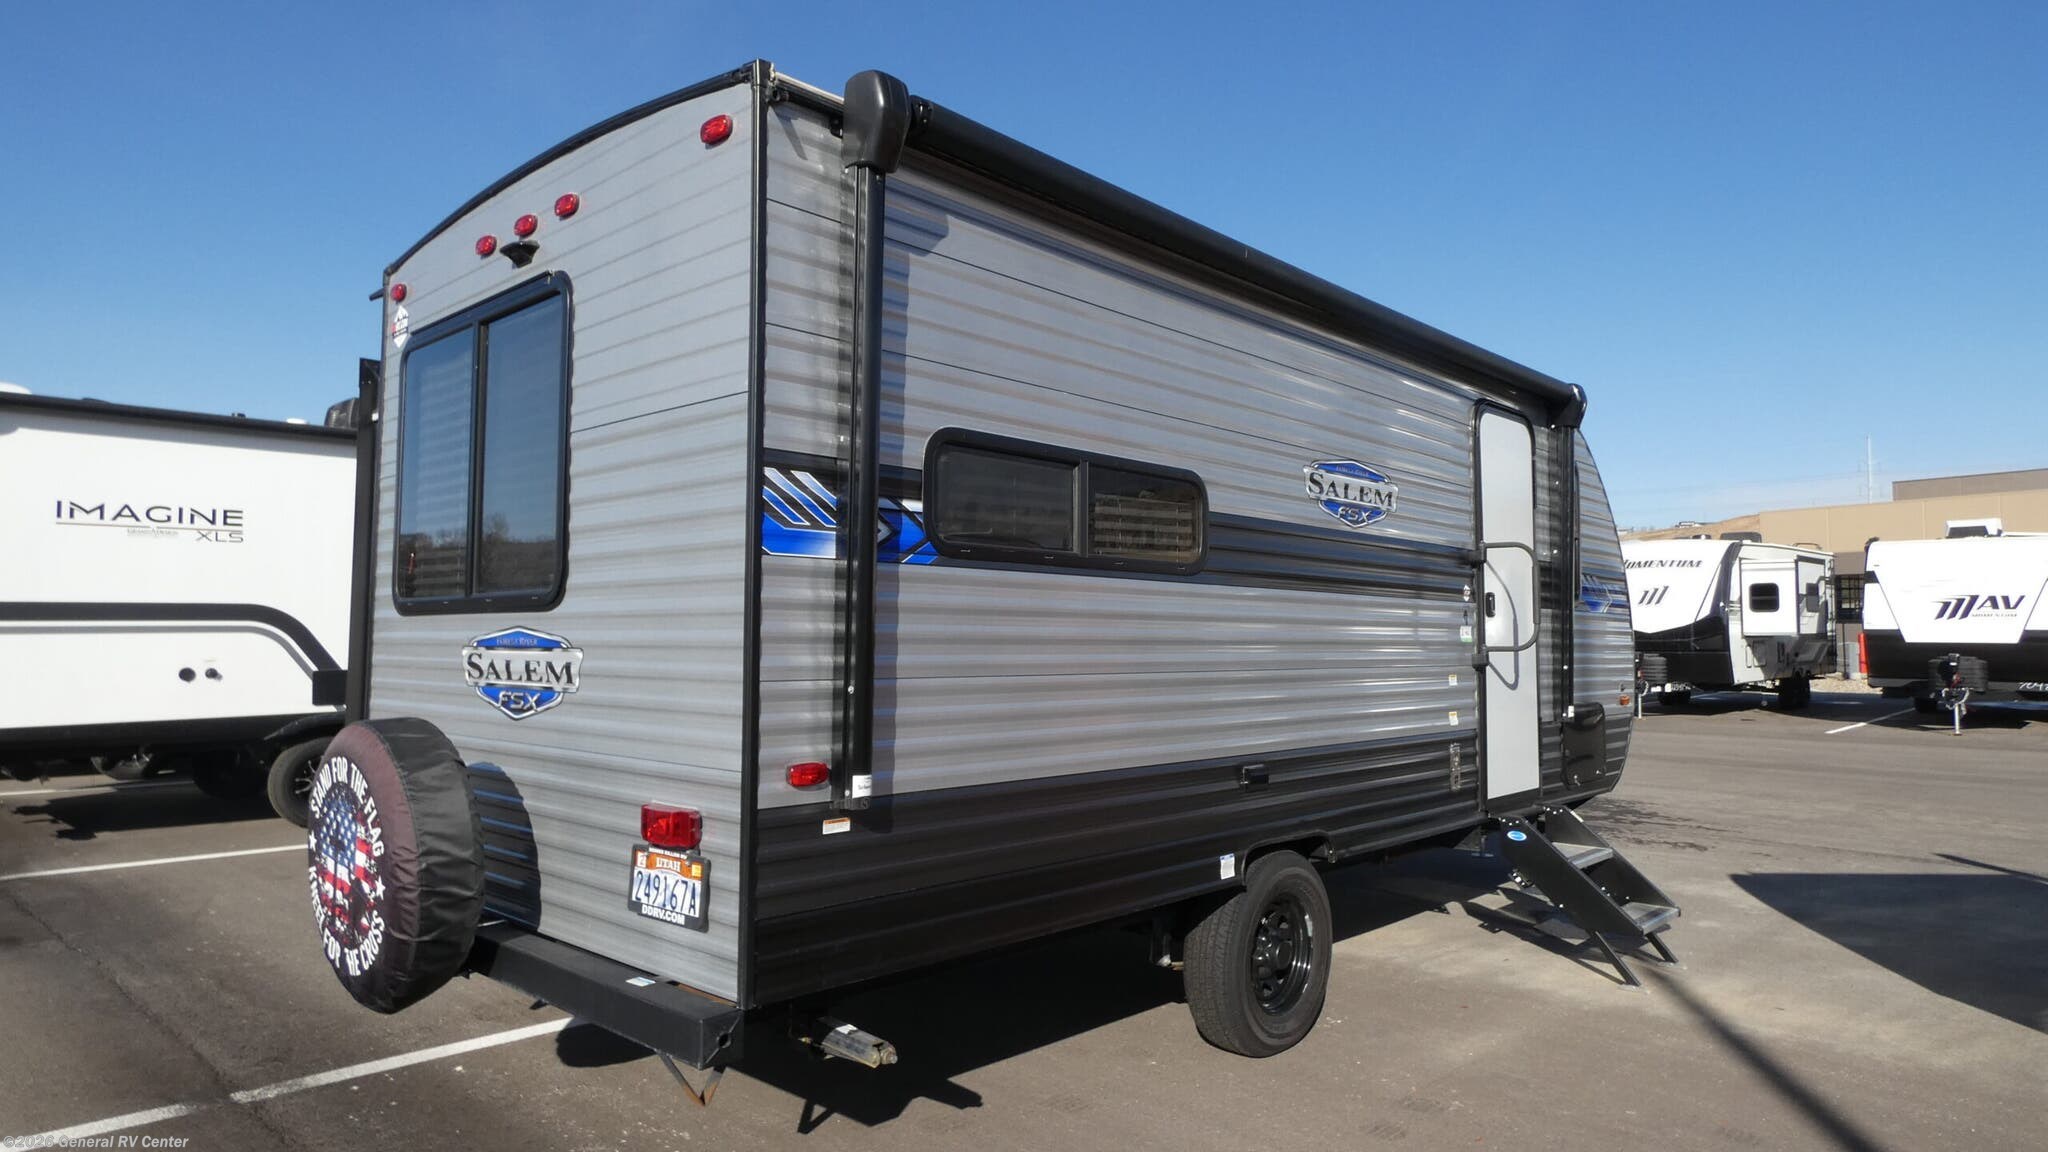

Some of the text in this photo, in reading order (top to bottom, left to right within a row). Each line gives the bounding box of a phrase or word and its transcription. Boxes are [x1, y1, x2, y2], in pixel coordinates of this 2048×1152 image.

[1308, 471, 1393, 507] SALEM
[56, 500, 244, 527] IMAGINE
[1338, 506, 1372, 523] FSX
[195, 531, 244, 543] XLS
[467, 652, 574, 688] SALEM
[498, 690, 541, 711] FSX
[310, 756, 385, 857] STAND FOR THE FLAG
[656, 857, 681, 872] UTAH
[641, 905, 686, 925] DDRV.COM
[323, 927, 341, 968] FOR
[344, 947, 361, 976] THE
[360, 910, 385, 970] CROSS
